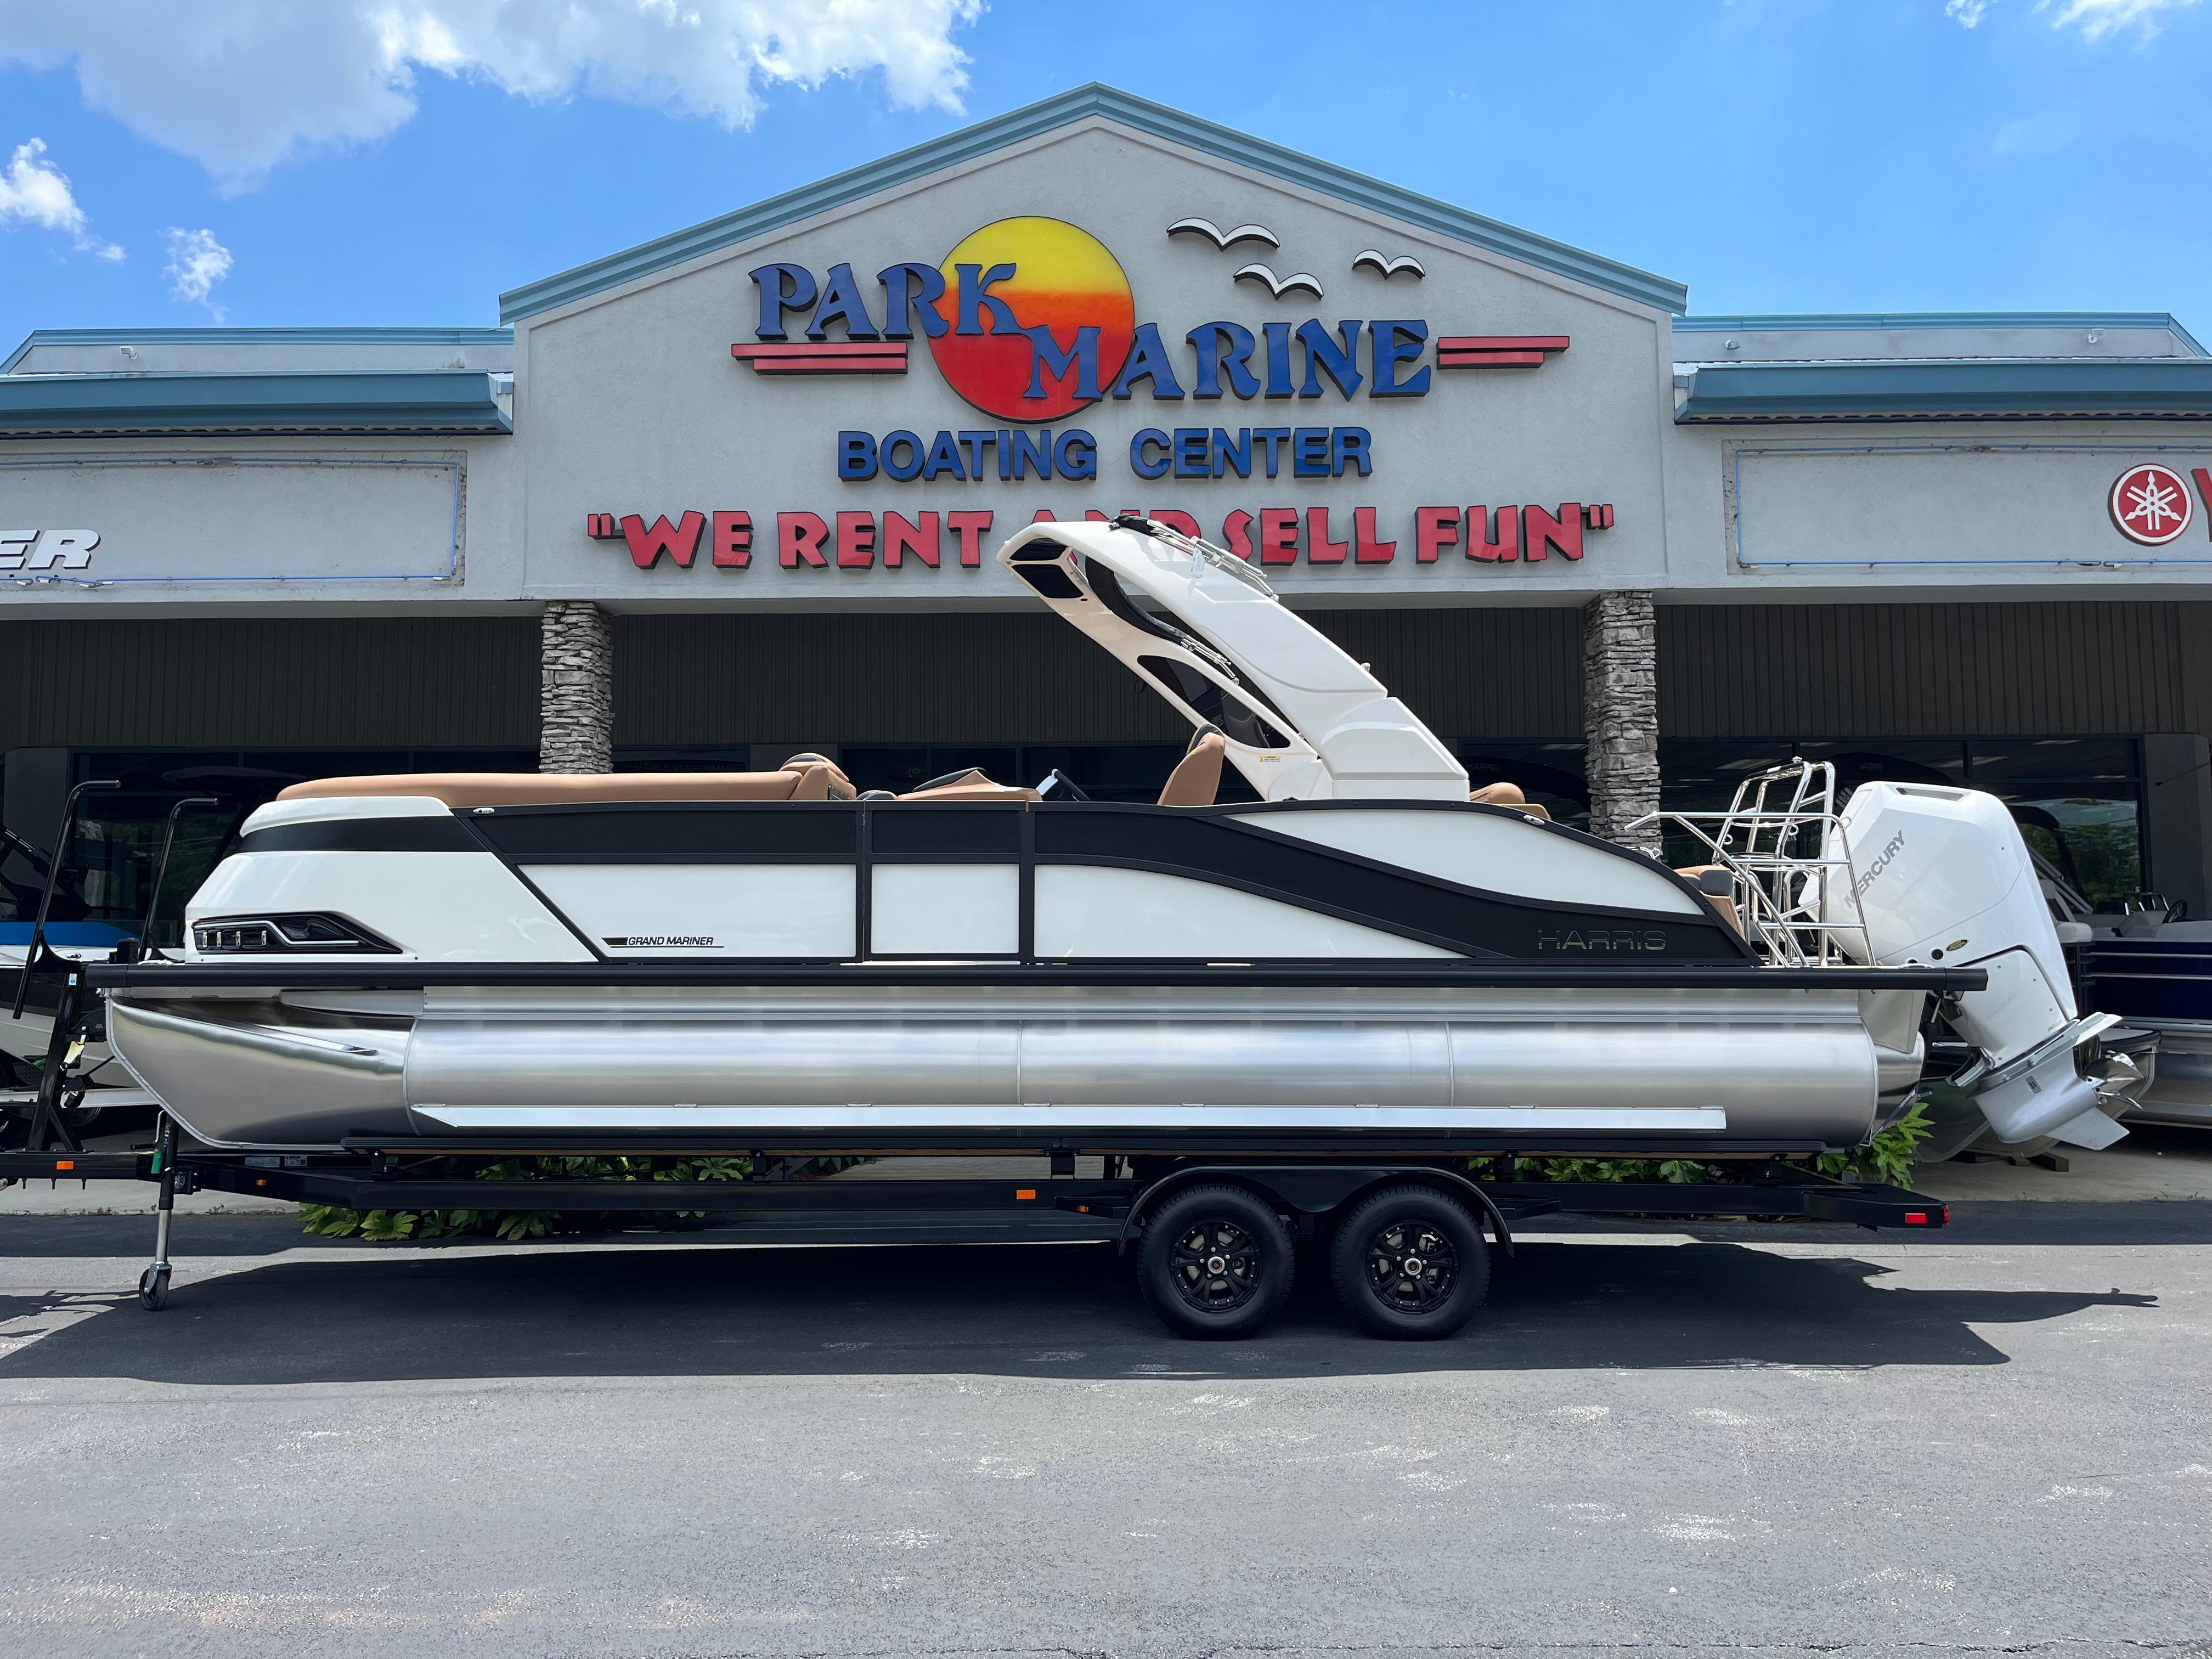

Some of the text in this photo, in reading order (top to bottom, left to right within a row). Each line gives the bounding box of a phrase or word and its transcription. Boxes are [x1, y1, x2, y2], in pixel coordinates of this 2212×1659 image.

[748, 262, 1034, 341] PARK
[1022, 319, 1431, 401] MARINE
[838, 427, 1373, 483] BOATING CENTER
[587, 510, 754, 569] "WE
[777, 510, 994, 569] RENT
[1222, 506, 1397, 566] SELL
[1415, 503, 1615, 564] FUN"
[1843, 829, 1905, 909] MERCURY
[628, 936, 664, 946] GRAND
[667, 936, 714, 946] MARINER
[1538, 930, 1666, 950] HARRIS
